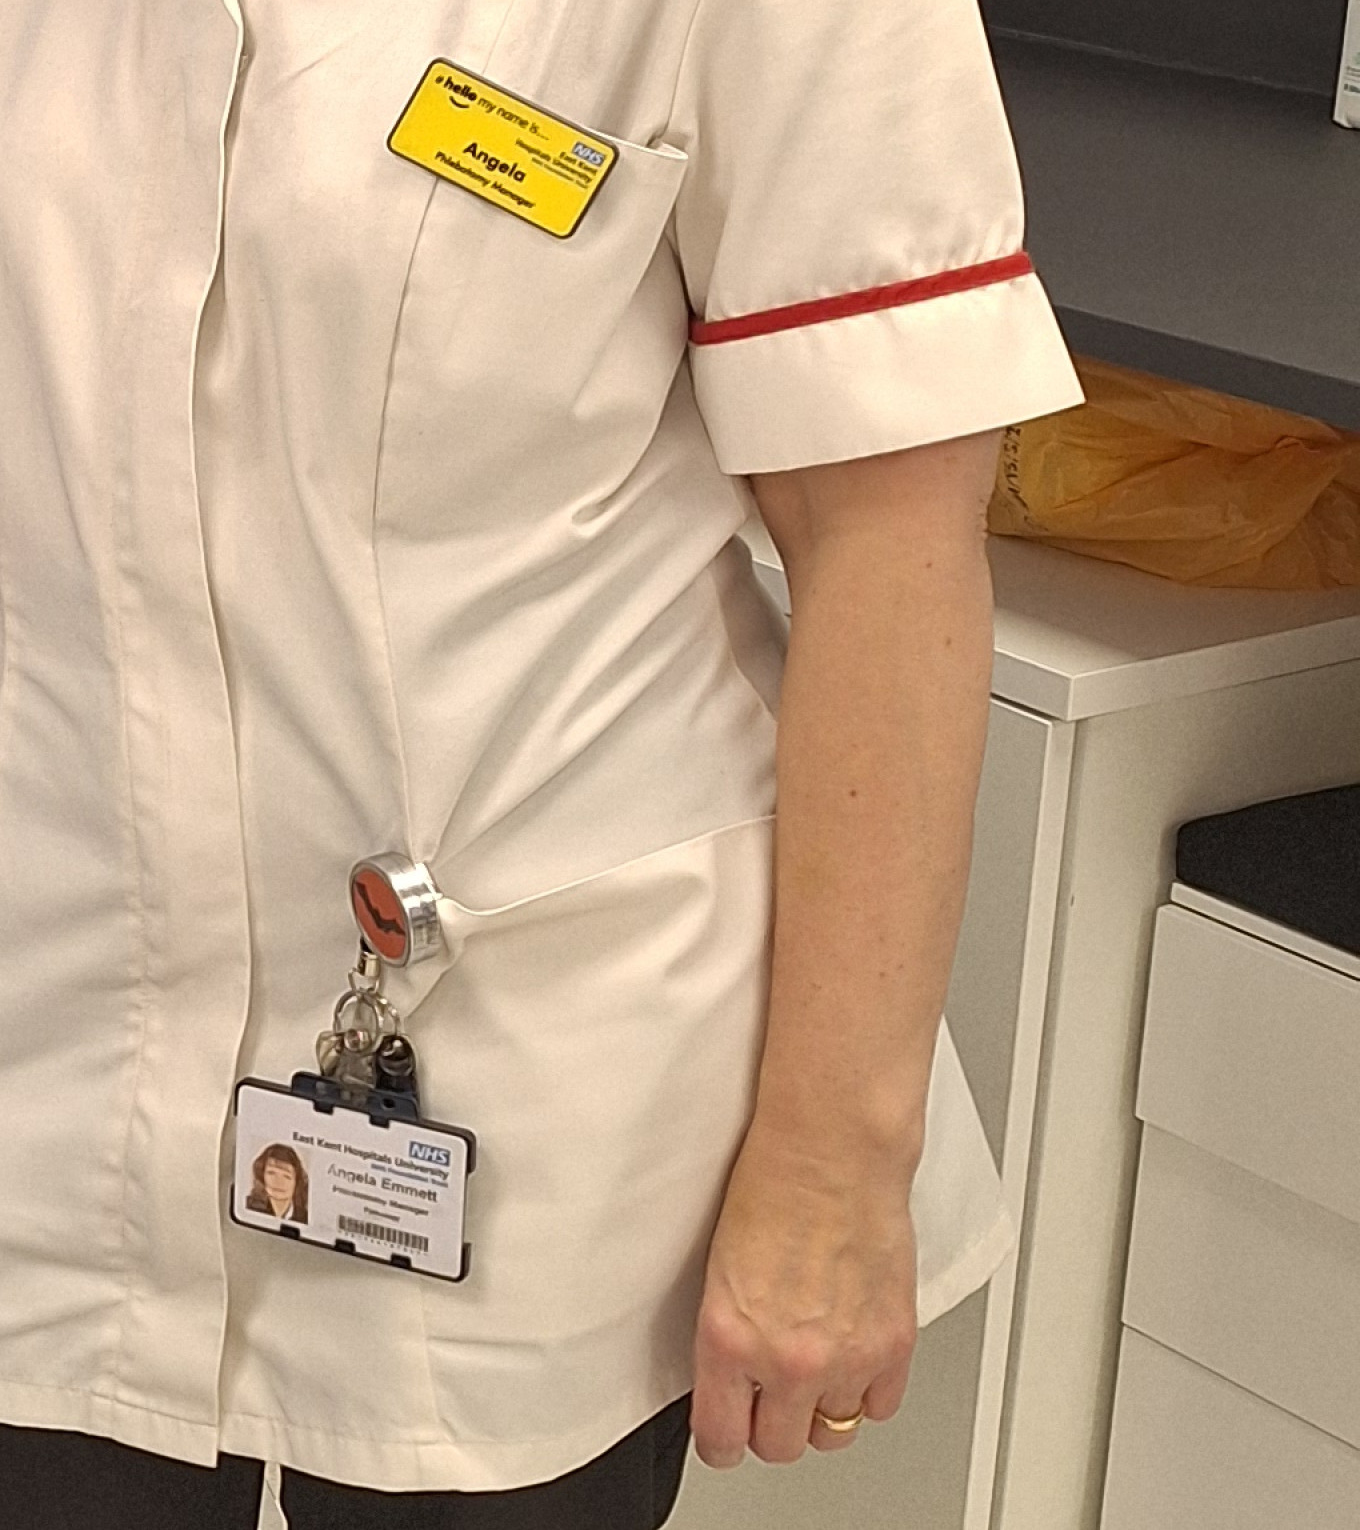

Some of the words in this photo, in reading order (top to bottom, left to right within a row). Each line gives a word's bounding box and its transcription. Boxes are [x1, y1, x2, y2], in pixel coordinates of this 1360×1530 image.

[477, 97, 497, 114] my
[496, 107, 530, 128] name
[463, 141, 527, 184] Angela
[573, 142, 605, 166] NHS
[491, 180, 537, 209] Manager
[293, 1131, 314, 1146] East
[316, 1137, 342, 1153] Kent
[343, 1144, 392, 1165] Hospitals
[395, 1157, 449, 1181] University
[411, 1144, 448, 1164] NHS
[327, 1163, 377, 1187] Angela
[381, 1177, 438, 1203] Emmett
